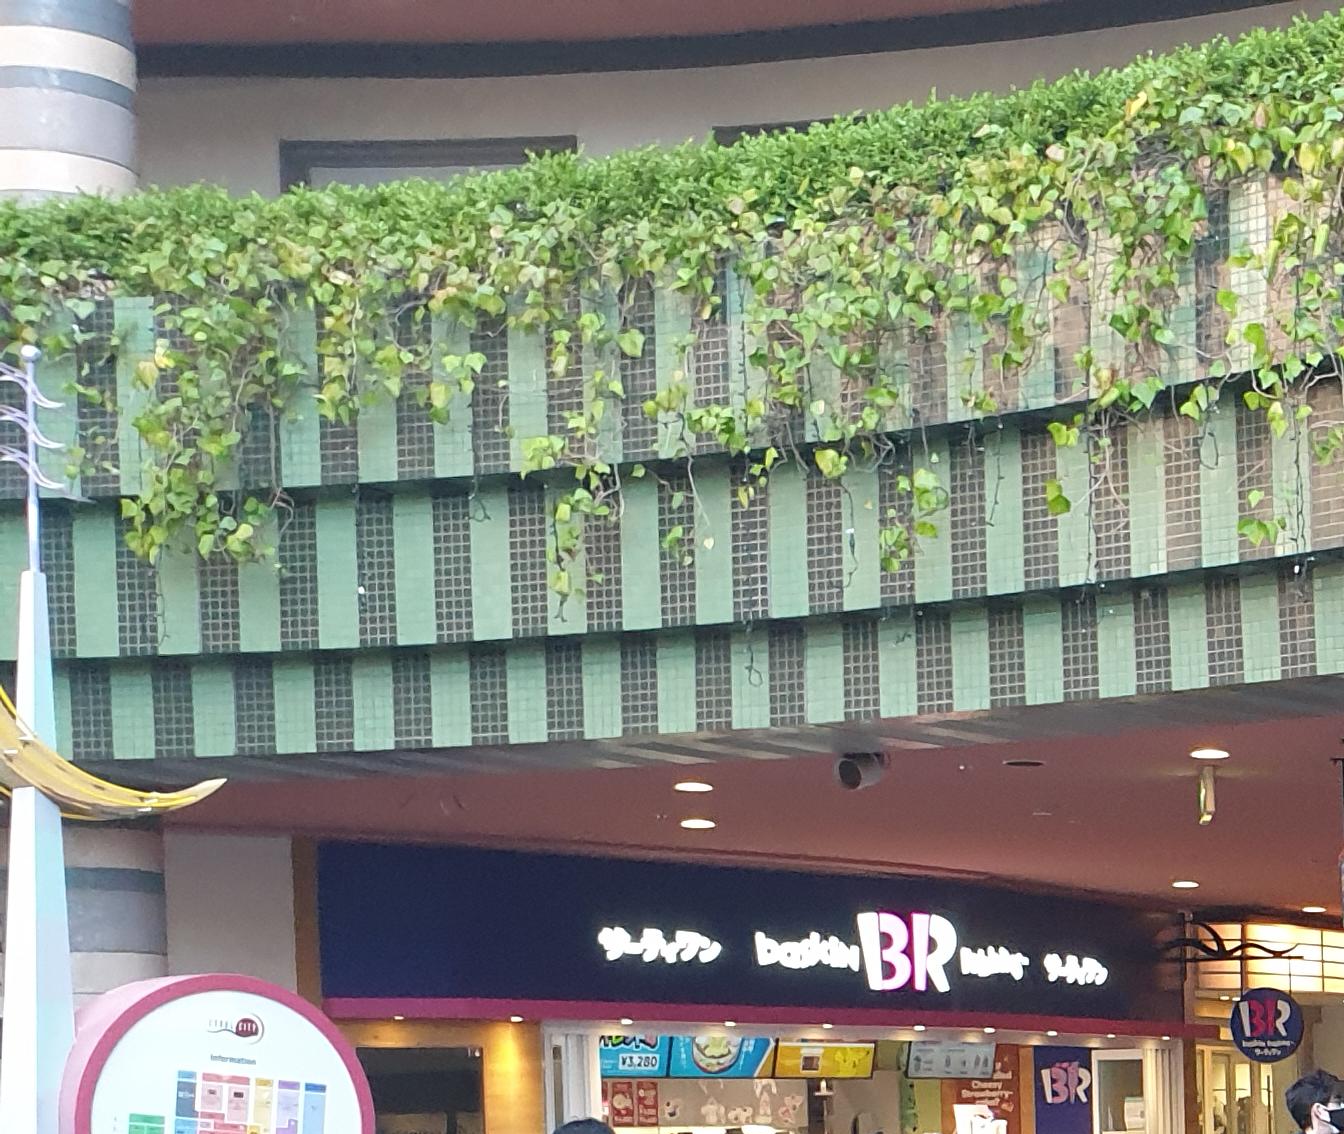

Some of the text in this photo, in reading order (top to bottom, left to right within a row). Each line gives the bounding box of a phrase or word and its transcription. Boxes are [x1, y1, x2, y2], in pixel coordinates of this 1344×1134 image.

[598, 926, 722, 963] サーティワン
[754, 931, 860, 972] baskin
[857, 911, 957, 992] BR
[1239, 999, 1291, 1037] BR
[1041, 1061, 1091, 1104] BR
